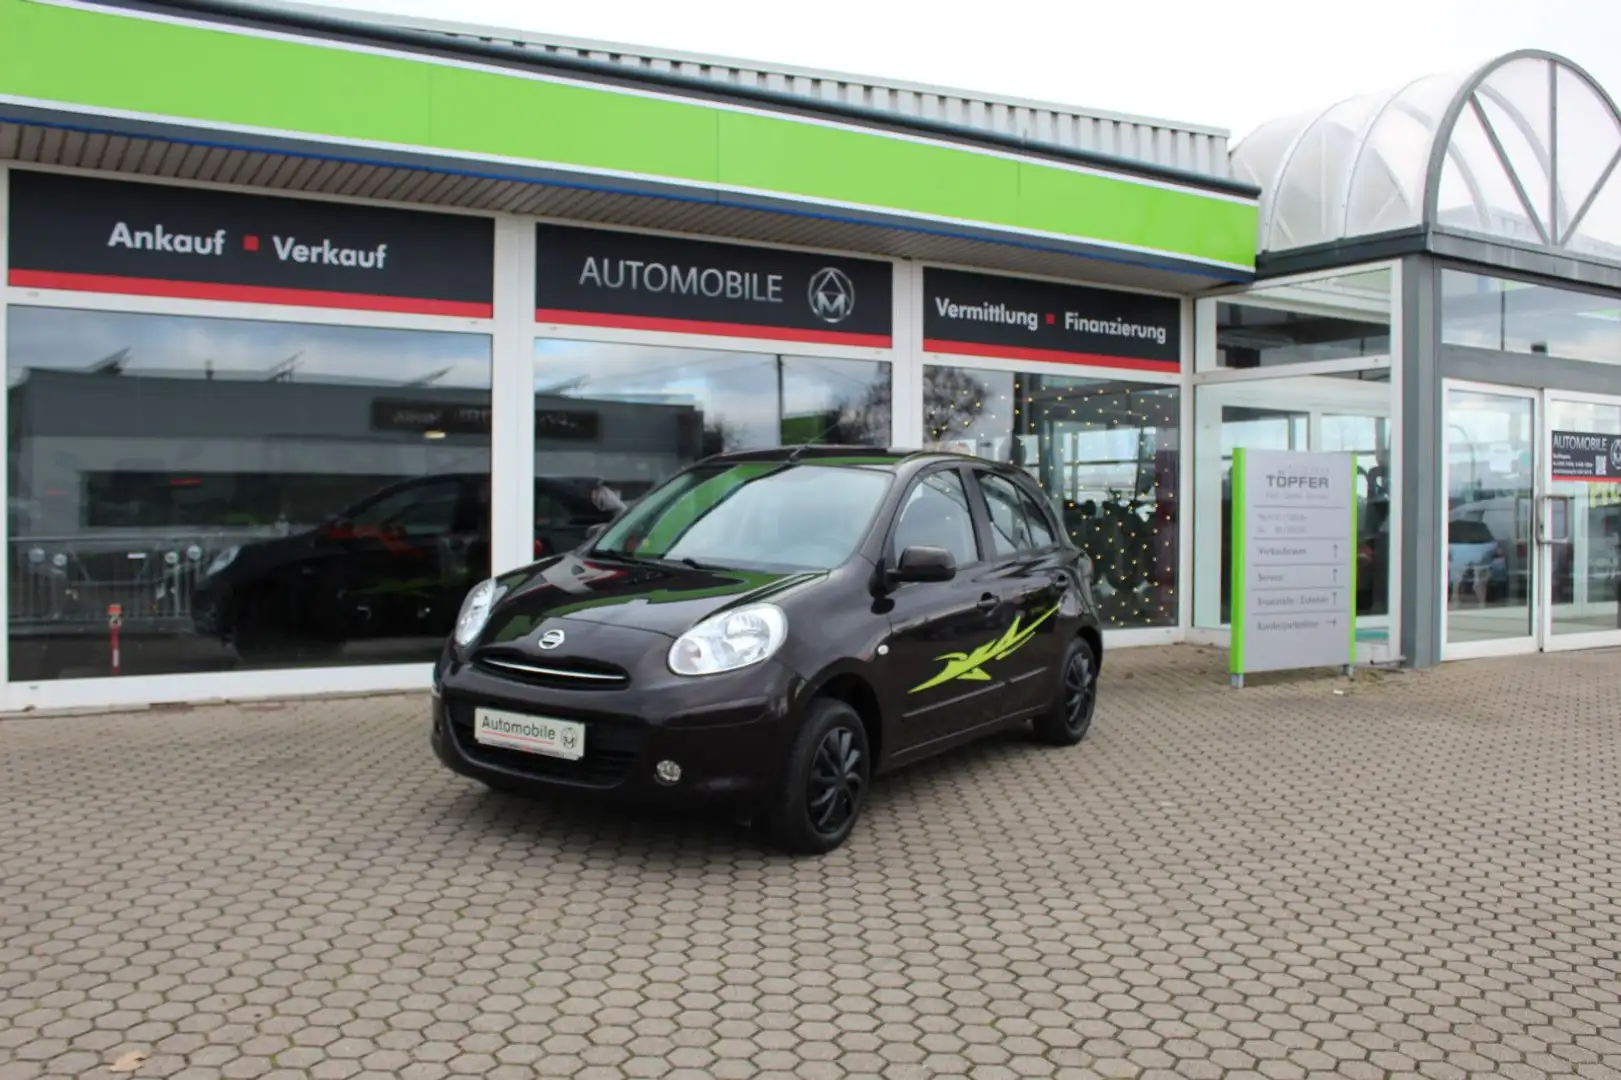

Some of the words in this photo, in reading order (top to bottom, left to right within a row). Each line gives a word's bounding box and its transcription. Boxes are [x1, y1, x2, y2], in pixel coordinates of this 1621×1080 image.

[107, 221, 226, 256] Ankauf
[272, 235, 388, 269] Verkauf
[578, 256, 783, 302] AUTOMOBILE
[935, 297, 1039, 331] Vermittlung
[1064, 312, 1167, 344] Finanzierung
[1553, 434, 1608, 452] AUTOMOBILE
[481, 715, 556, 740] Automobile
